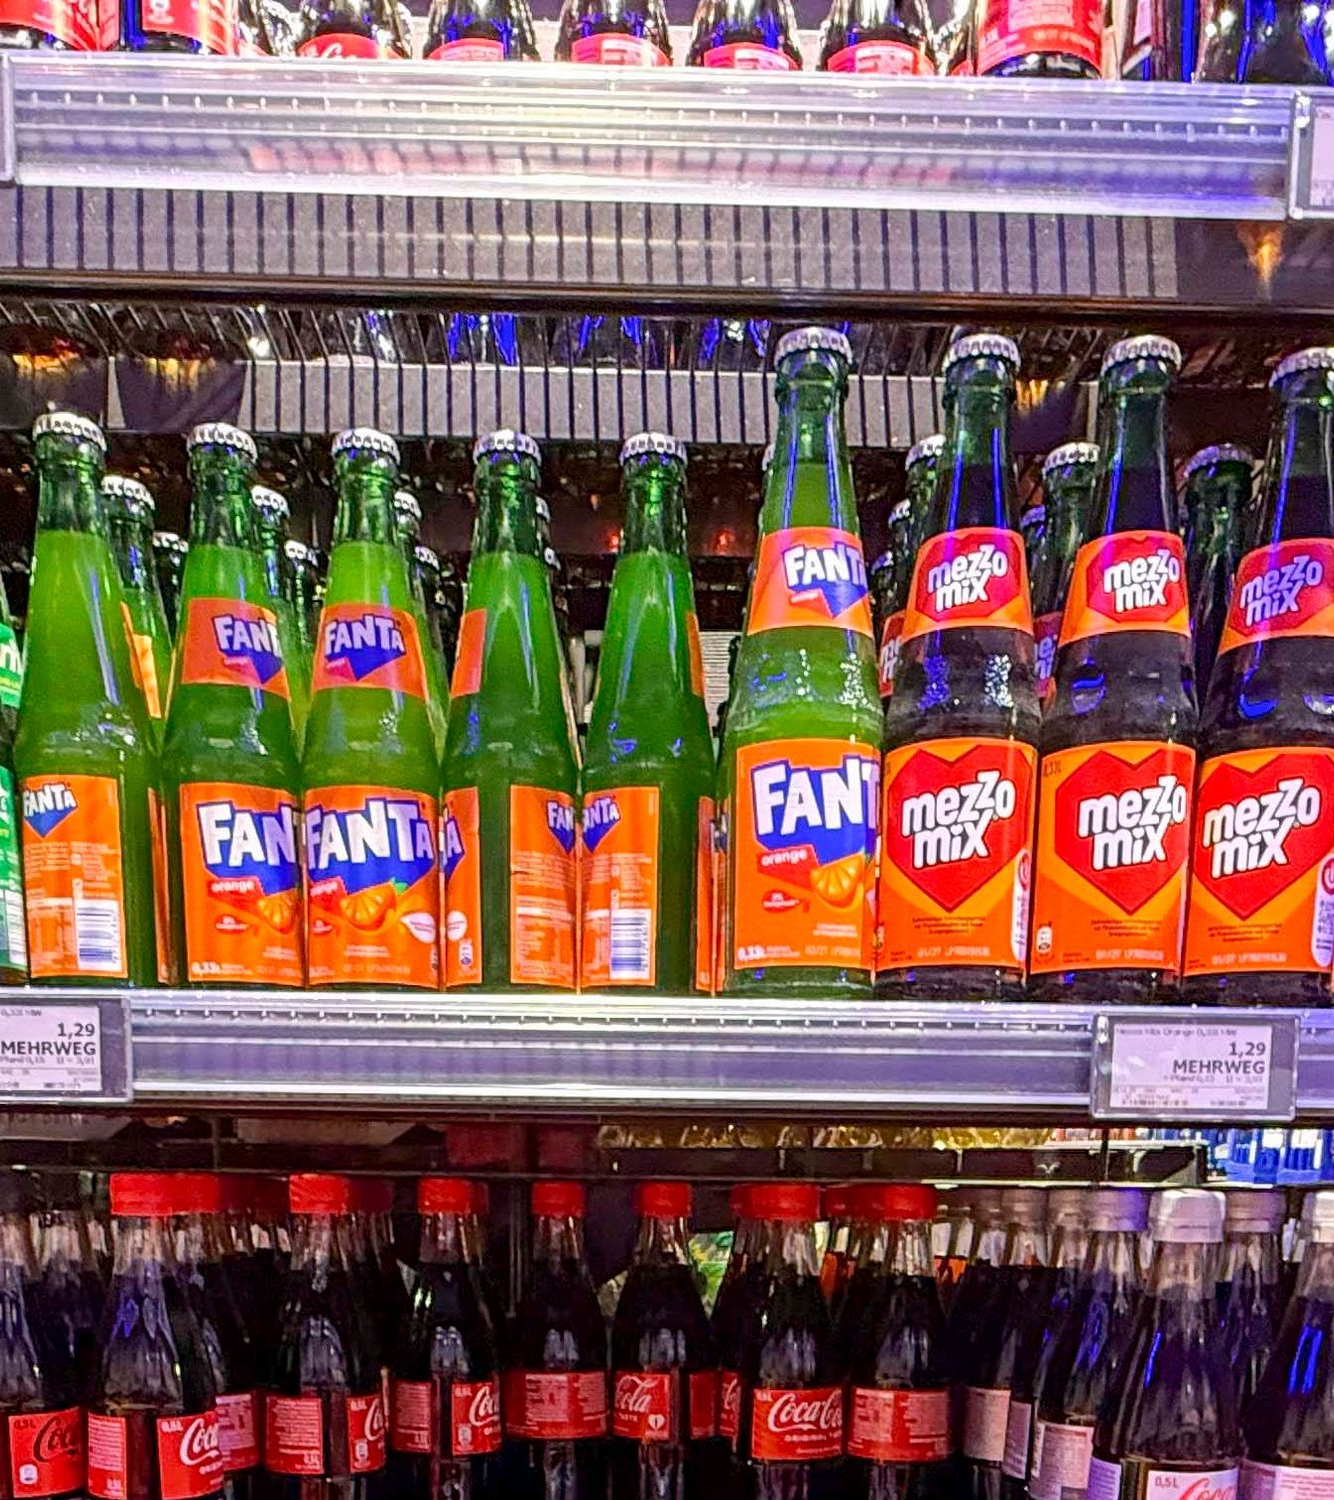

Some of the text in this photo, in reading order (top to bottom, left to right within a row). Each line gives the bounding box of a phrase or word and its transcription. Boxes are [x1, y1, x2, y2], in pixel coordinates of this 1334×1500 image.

[926, 544, 1008, 594] mezzo
[1103, 548, 1181, 589] mezzo
[1239, 554, 1324, 598] mezzo
[935, 573, 990, 613] mix
[1114, 578, 1168, 613] mix
[1245, 585, 1300, 627] mix
[325, 615, 405, 653] FANTA
[22, 782, 77, 816] FANTA
[753, 757, 881, 836] FANT
[902, 769, 1016, 837] mezzo
[1077, 775, 1187, 836] mezzo
[1203, 777, 1322, 846] mezzo
[198, 802, 297, 868] FAN
[912, 808, 992, 870] mix
[1091, 817, 1171, 871] mix
[1210, 829, 1291, 879] mix
[761, 848, 808, 867] orange
[0, 1040, 97, 1057] MEHRWEG
[56, 1022, 96, 1040] 1,29
[1228, 1041, 1267, 1059] 1,29
[1172, 1059, 1266, 1075] MEHRWEG
